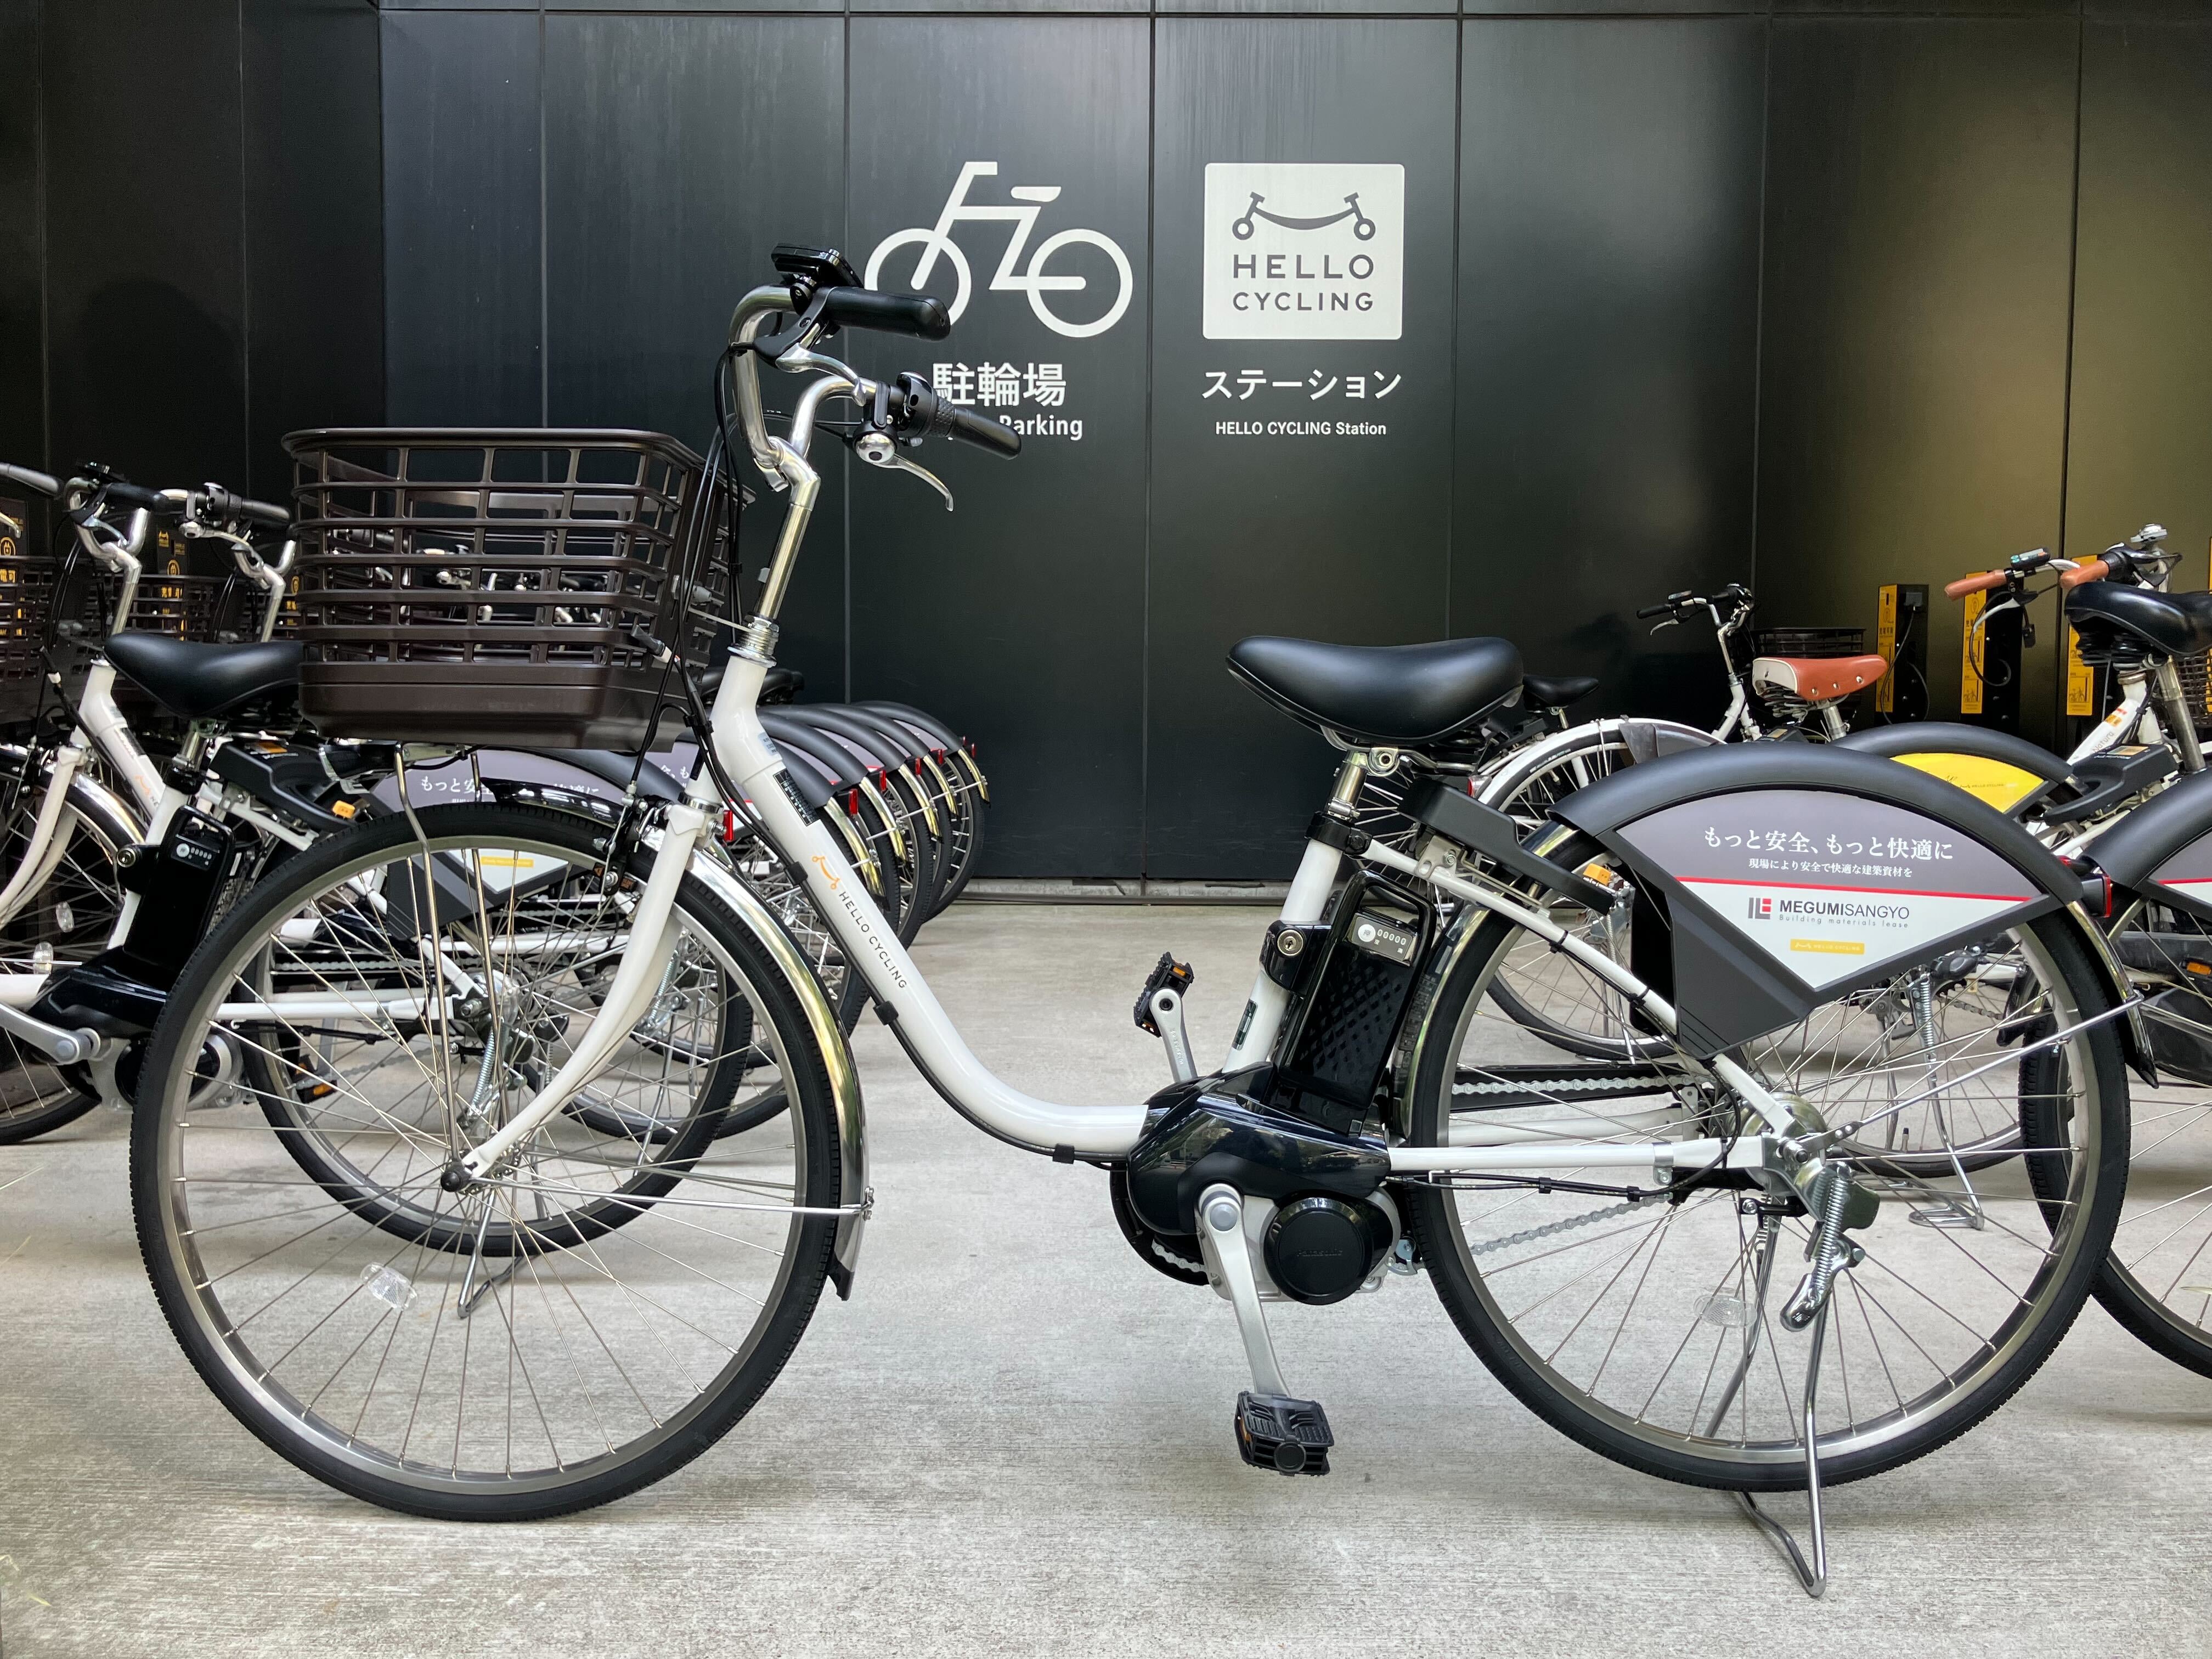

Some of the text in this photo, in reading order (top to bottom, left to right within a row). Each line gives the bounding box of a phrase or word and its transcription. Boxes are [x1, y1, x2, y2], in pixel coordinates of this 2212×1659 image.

[1233, 254, 1374, 280] HELLO
[1233, 292, 1373, 312] CYCLING
[933, 362, 1066, 407] 駐輪場
[1201, 369, 1401, 400] ステーション
[1216, 421, 1386, 435] HELLO CYCLING Station
[1779, 915, 1822, 924] Building
[1780, 900, 1910, 919] MEGUMISANGYO
[838, 892, 907, 989] HELLO CYCLING
